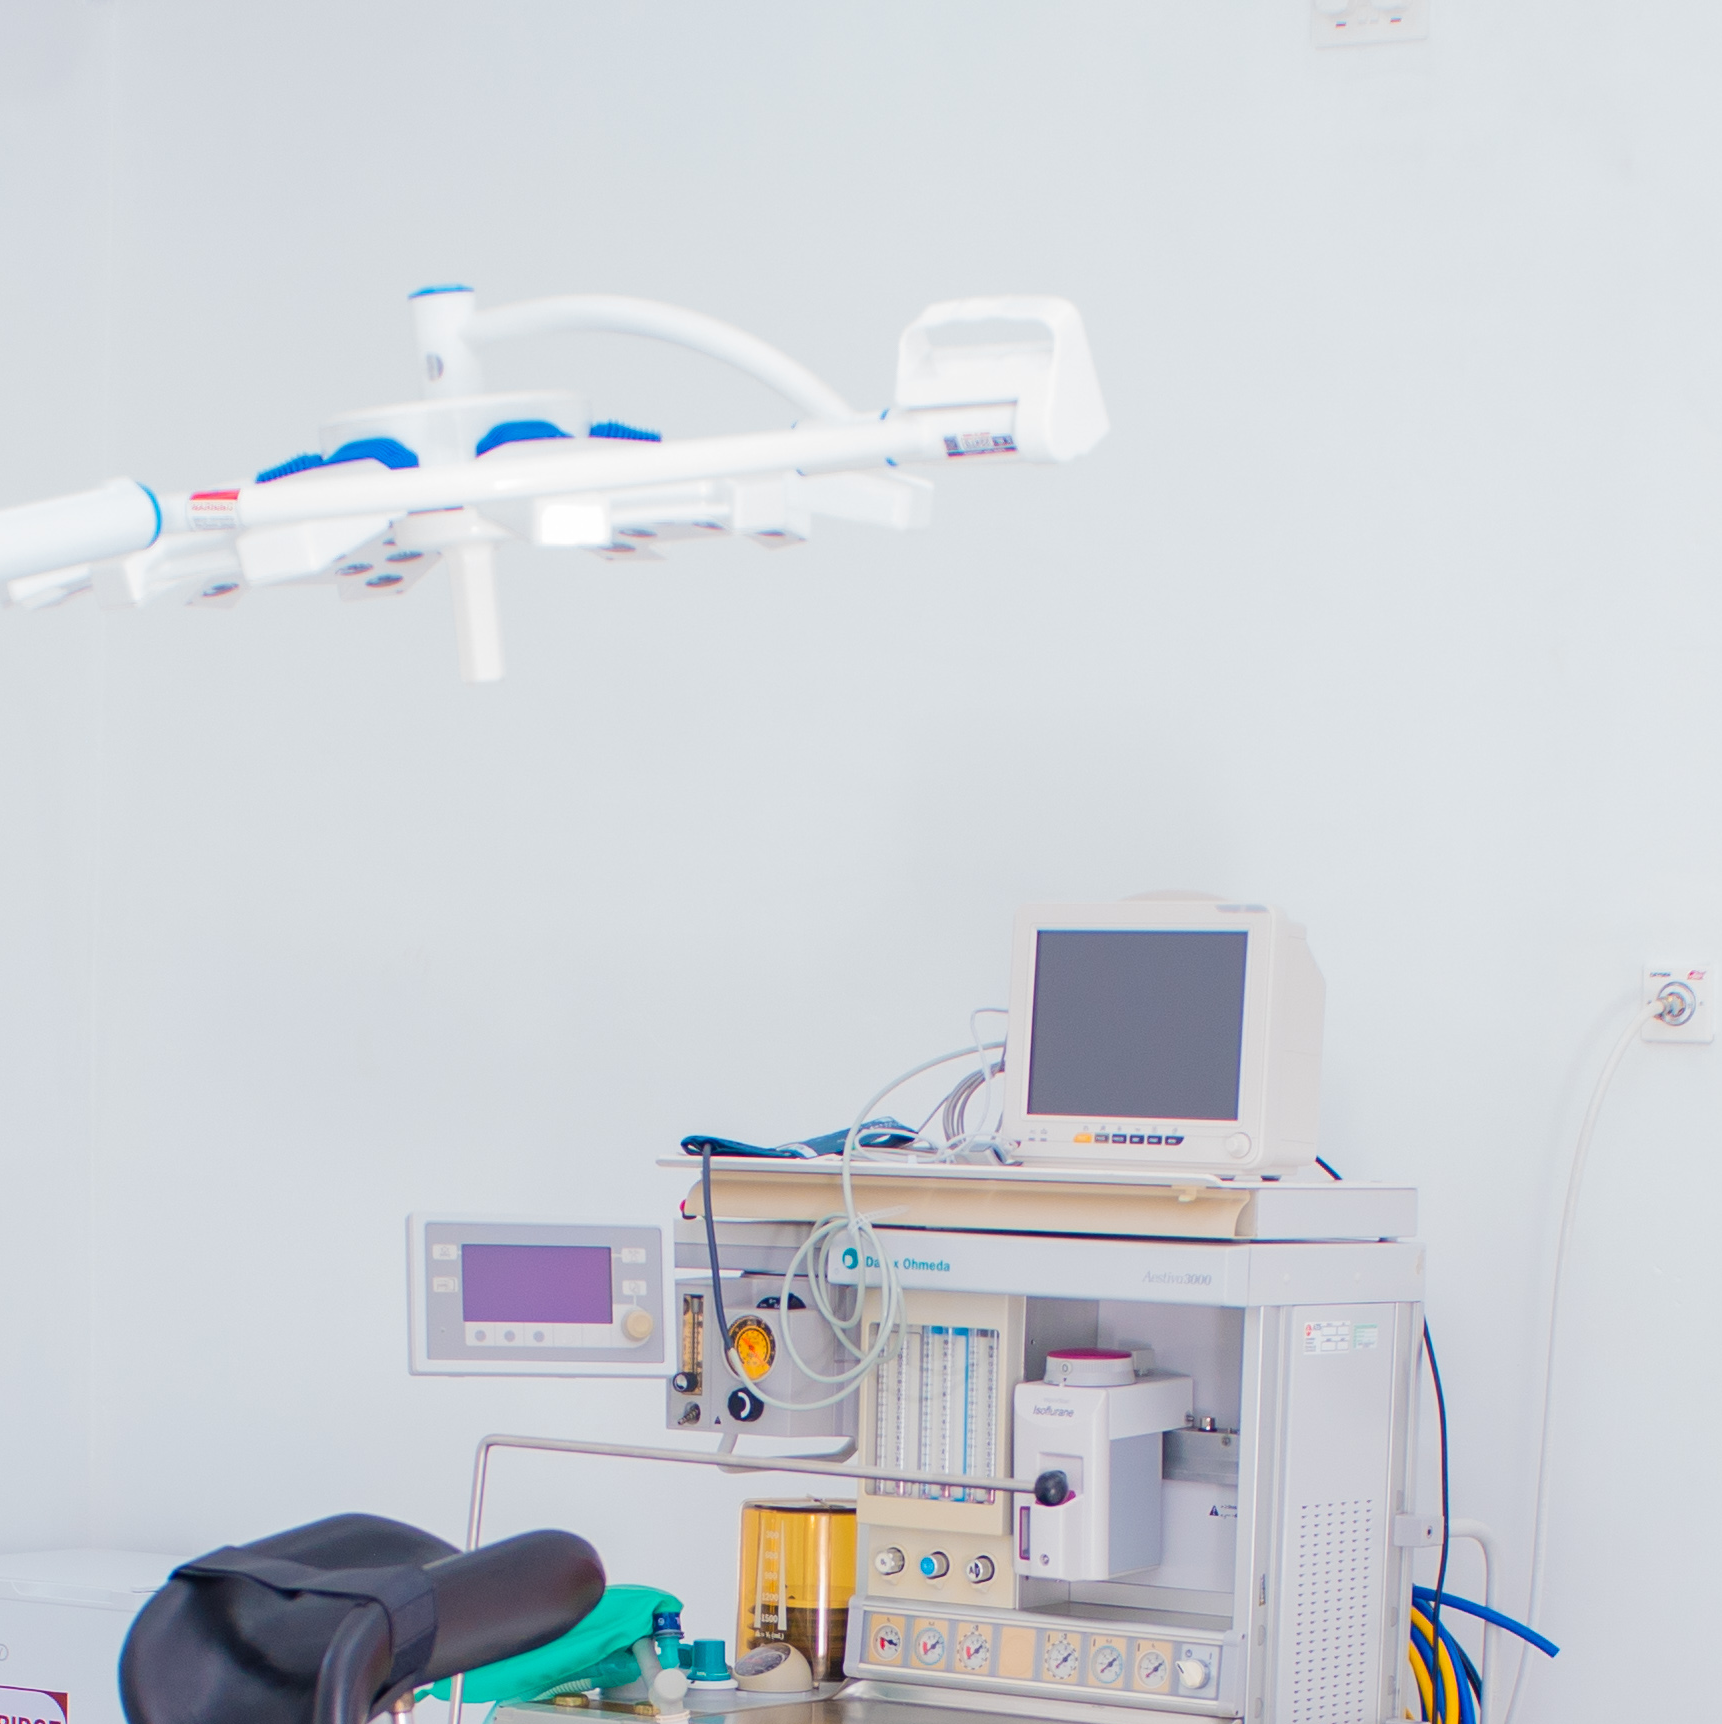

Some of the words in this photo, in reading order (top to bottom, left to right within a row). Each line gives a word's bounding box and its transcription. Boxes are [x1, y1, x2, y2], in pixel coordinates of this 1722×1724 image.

[865, 1255, 899, 1269] Dax
[903, 1257, 951, 1272] Ohmeda
[1033, 1405, 1075, 1418] Isoflurane
[761, 1613, 779, 1623] 1500
